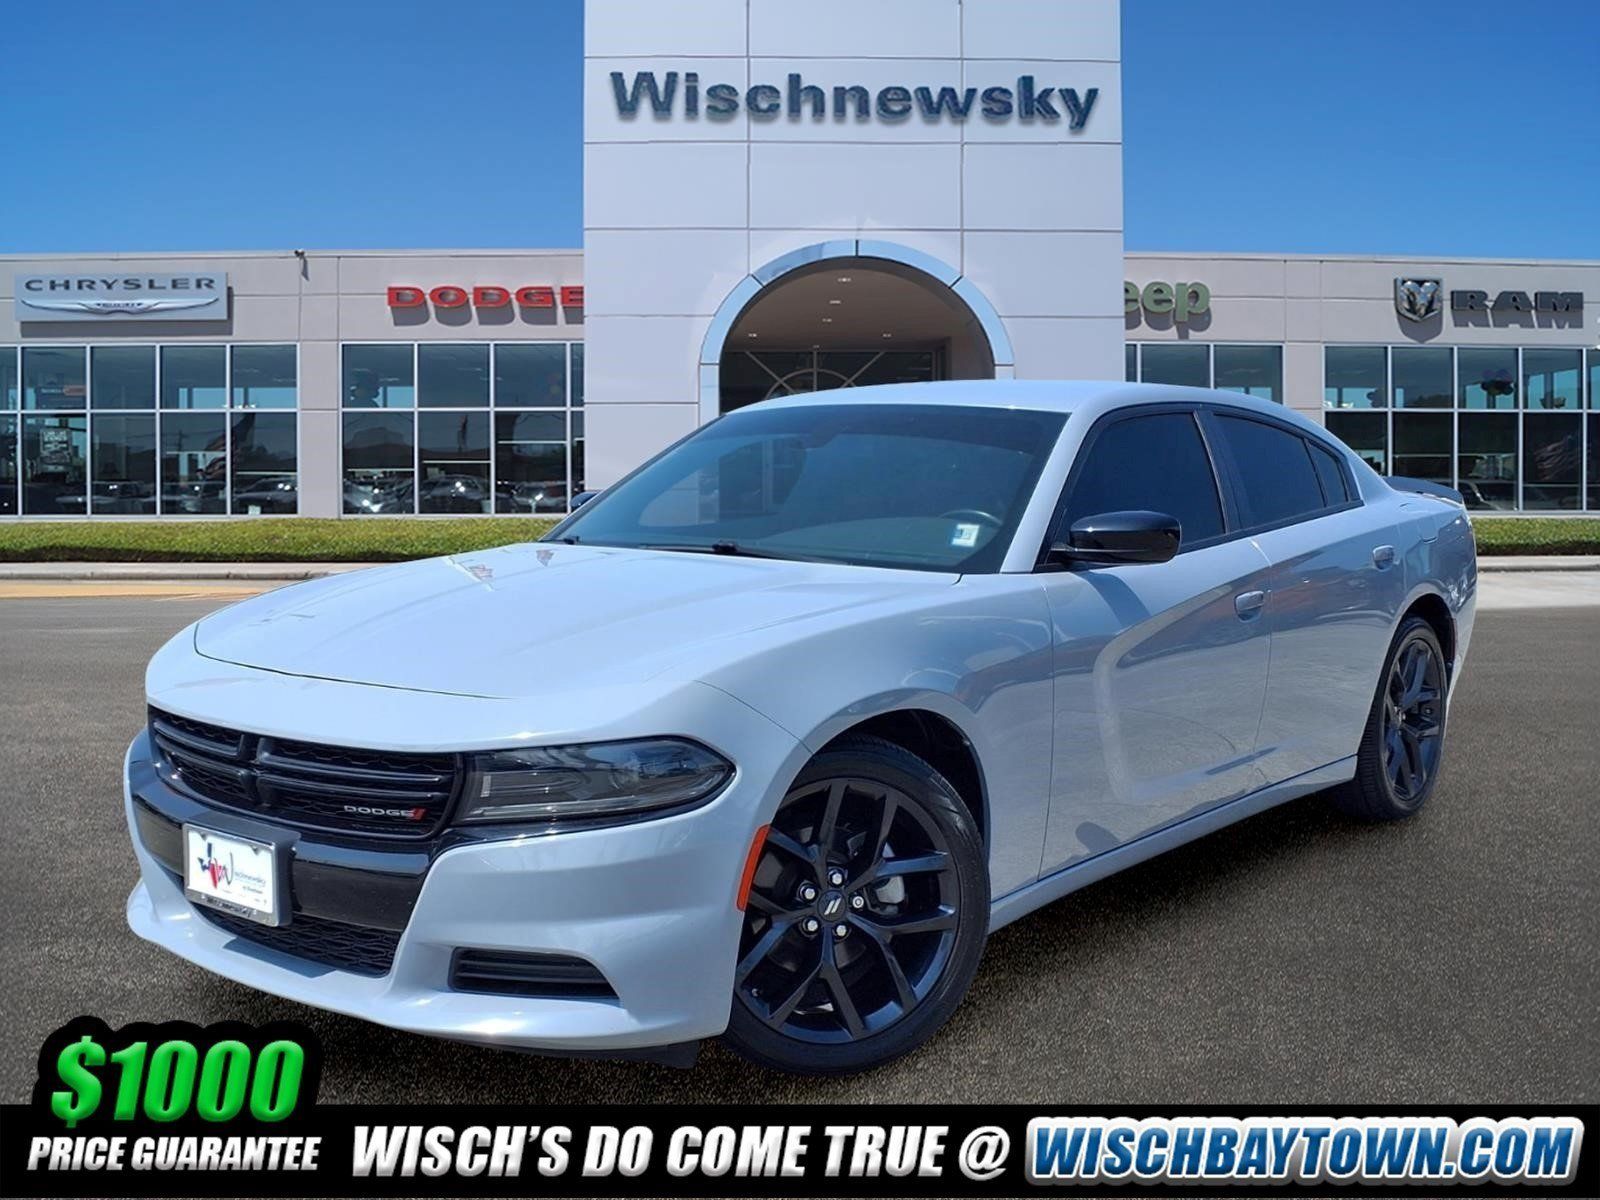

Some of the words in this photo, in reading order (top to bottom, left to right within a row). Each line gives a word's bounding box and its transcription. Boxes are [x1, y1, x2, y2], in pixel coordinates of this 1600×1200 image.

[610, 71, 1099, 130] Wischnewsky
[25, 278, 216, 291] CHRYSLER
[387, 286, 584, 307] DODGE
[1451, 291, 1584, 311] RAM
[343, 805, 414, 817] DODGE
